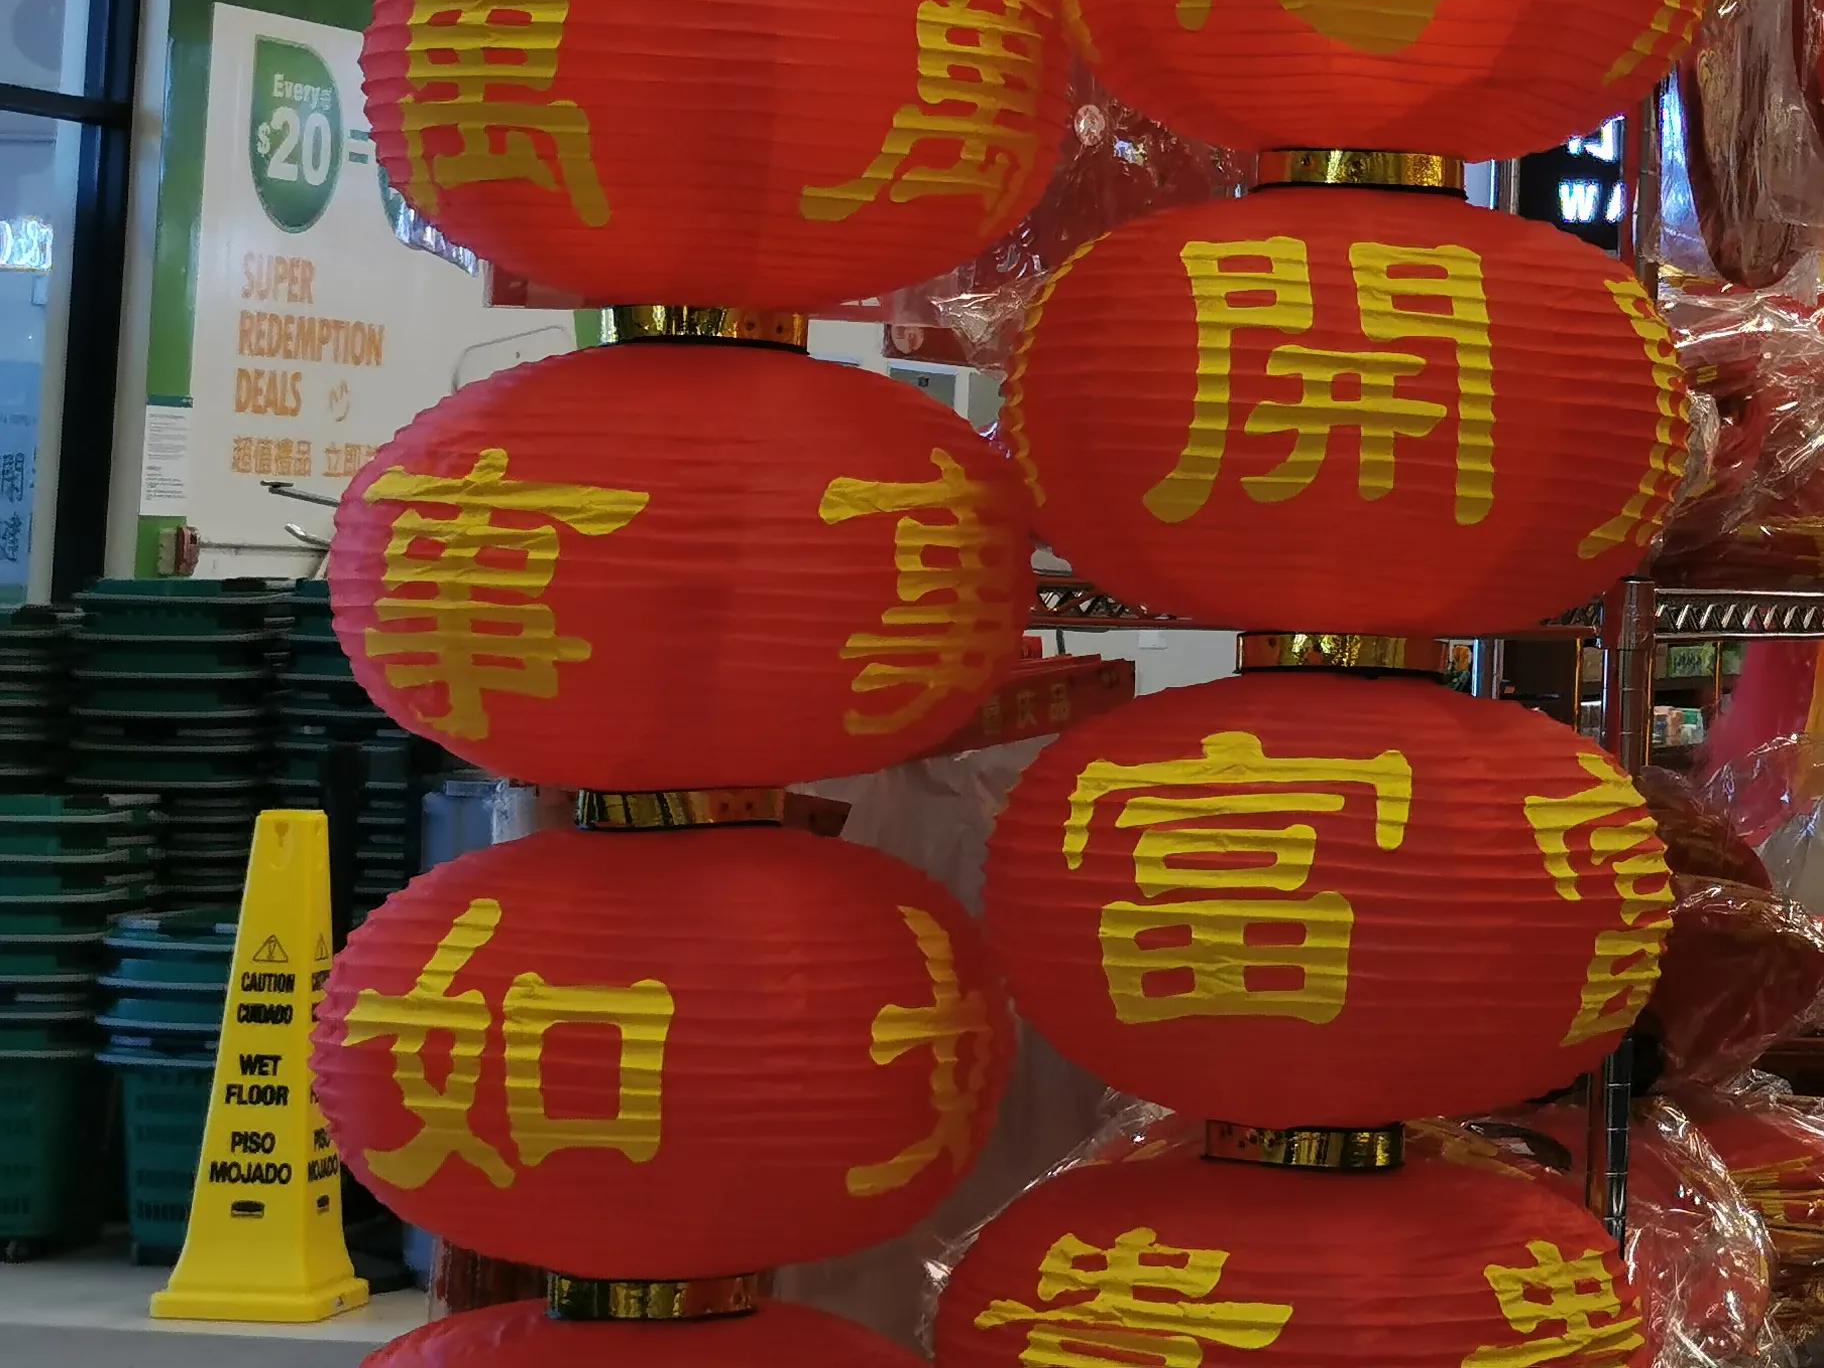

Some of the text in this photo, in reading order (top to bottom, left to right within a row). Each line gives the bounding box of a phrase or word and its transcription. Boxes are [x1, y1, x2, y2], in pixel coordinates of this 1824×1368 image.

[273, 73, 320, 109] Every
[257, 106, 332, 185] $20
[241, 253, 315, 303] SUPER
[238, 310, 386, 367] REDEMPTION
[235, 369, 302, 417] DEALS
[1142, 236, 1494, 525] 開
[322, 442, 379, 477] 立即
[1062, 732, 1413, 1024] 富
[241, 972, 295, 993] CAUTION
[237, 1003, 293, 1024] CUIDADO
[341, 898, 675, 1189] 如
[240, 1054, 282, 1076] WET
[225, 1084, 289, 1106] FLOOR
[231, 1131, 276, 1154] PISO
[209, 1161, 292, 1184] MOJADO
